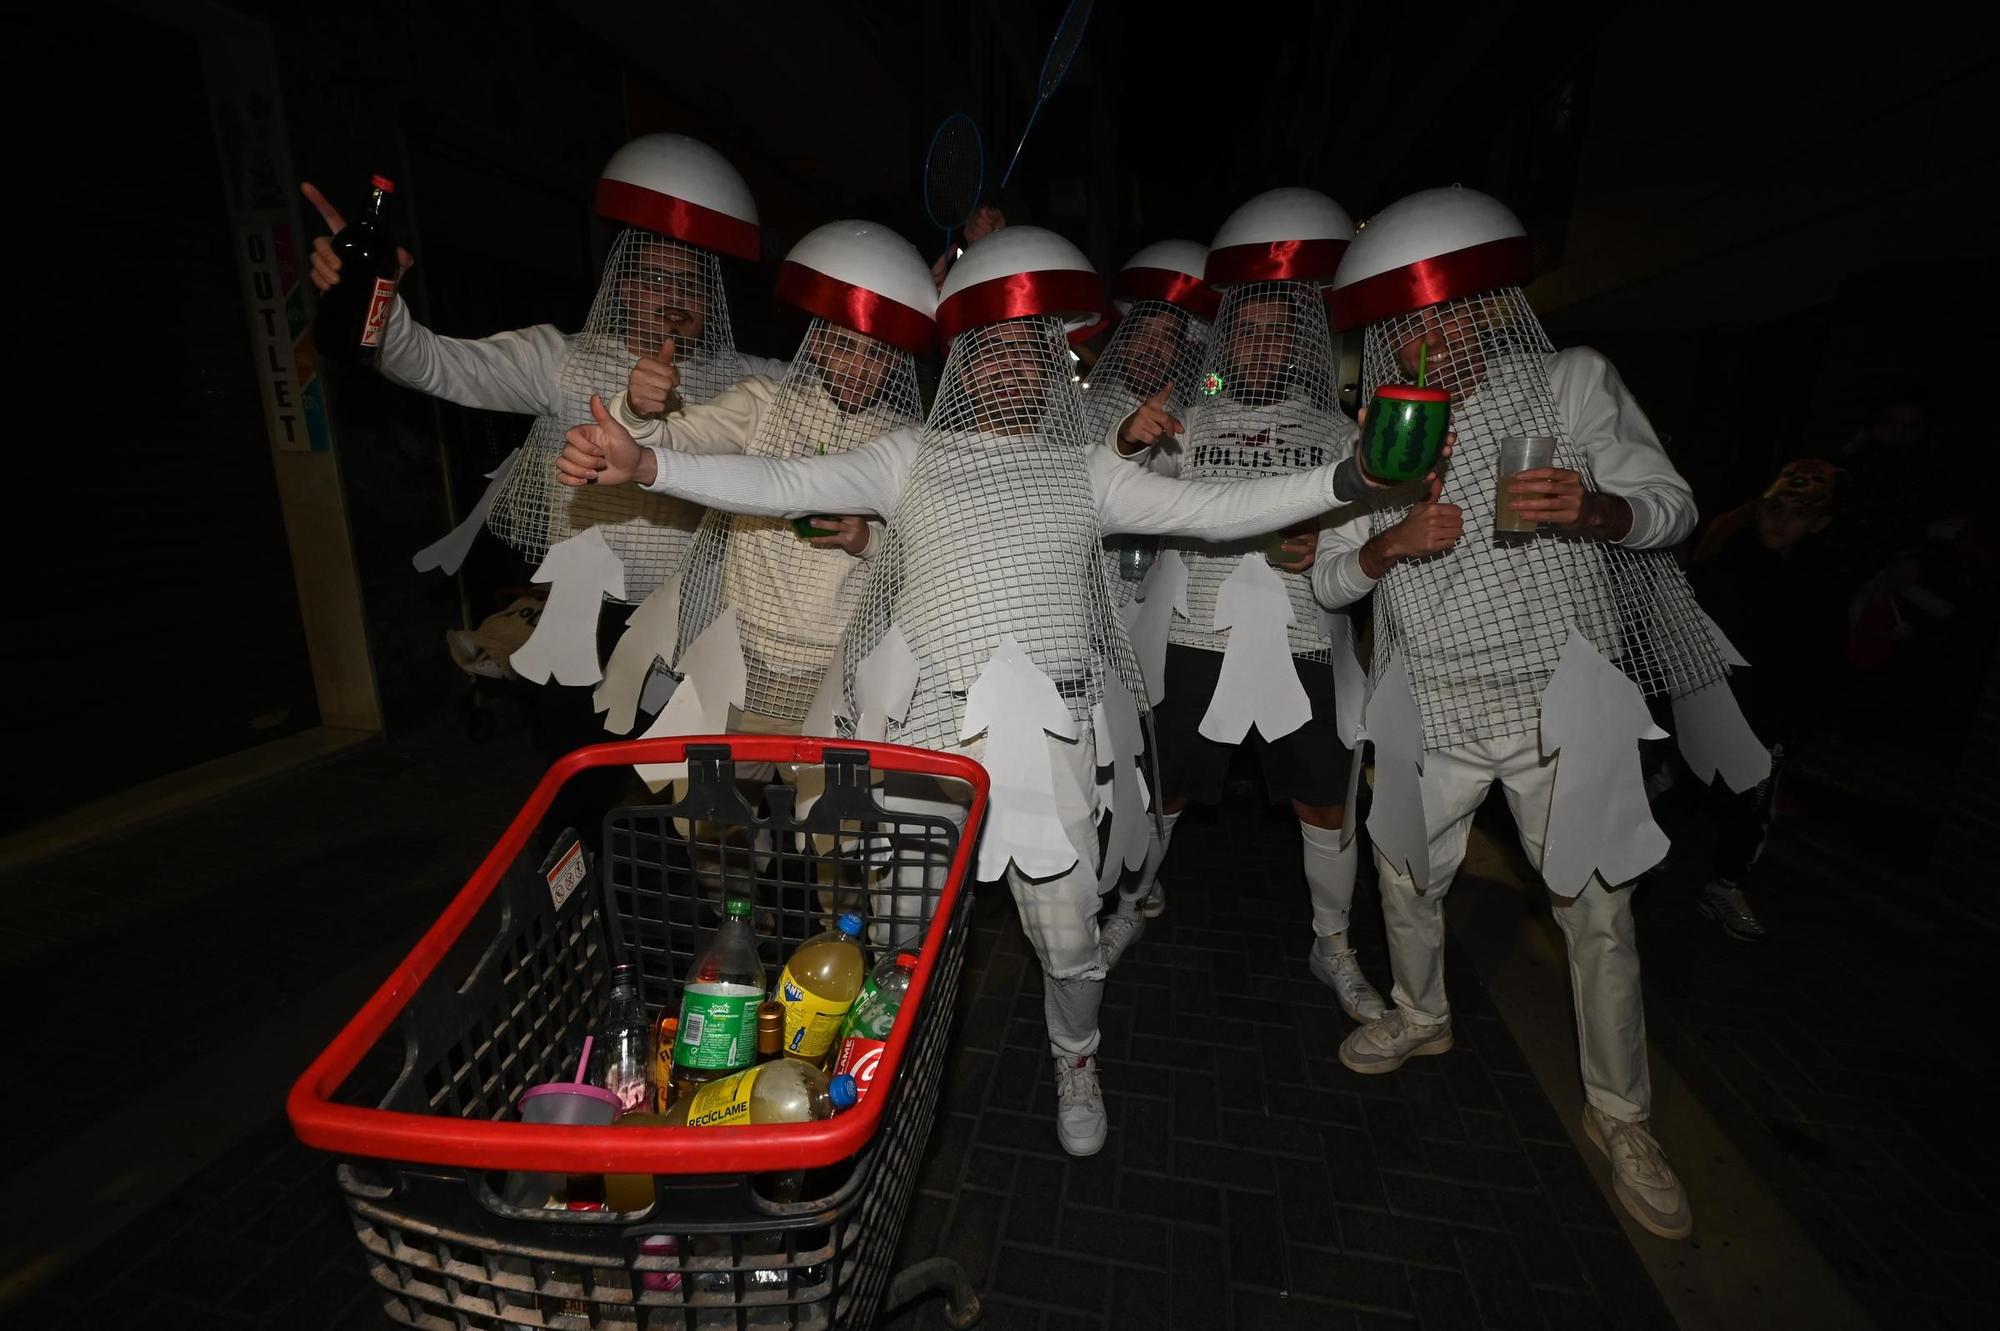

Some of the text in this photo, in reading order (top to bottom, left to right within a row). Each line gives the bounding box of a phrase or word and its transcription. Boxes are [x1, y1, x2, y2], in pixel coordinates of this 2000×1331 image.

[247, 234, 296, 443] OUTLET
[1194, 445, 1323, 468] HOLLISTER
[837, 1039, 853, 1075] LAME
